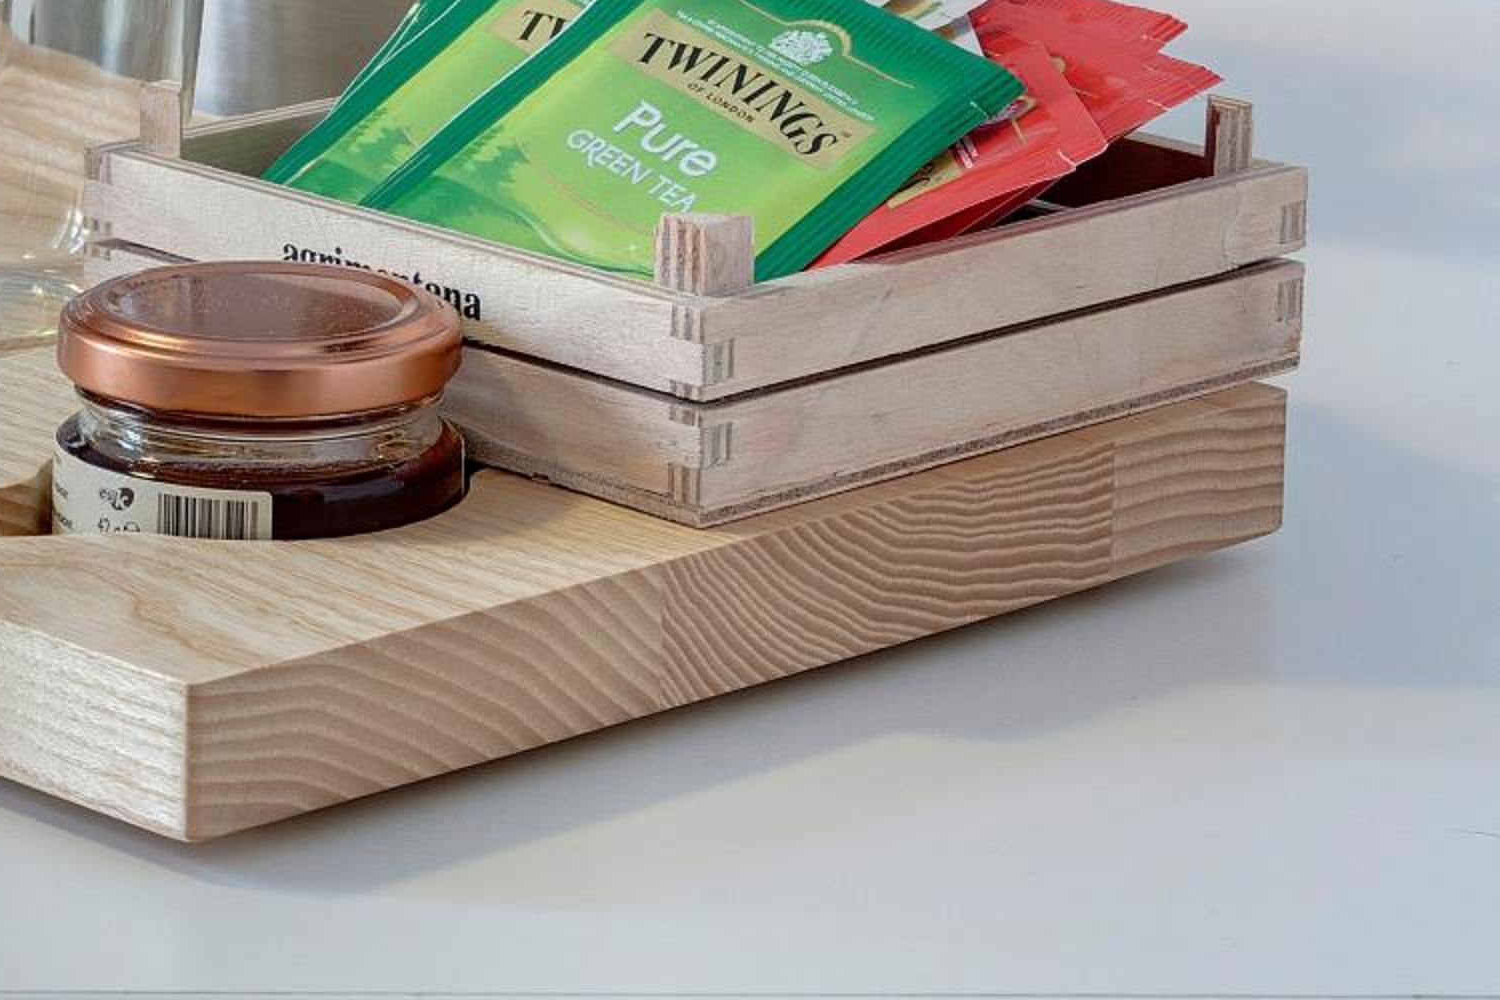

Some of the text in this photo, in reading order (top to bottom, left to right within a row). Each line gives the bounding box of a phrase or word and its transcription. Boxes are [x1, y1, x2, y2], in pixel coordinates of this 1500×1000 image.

[639, 33, 838, 155] TWININGS
[687, 81, 756, 124] OF LONDON
[566, 129, 697, 214] GREEN TEA
[612, 99, 717, 177] Pure
